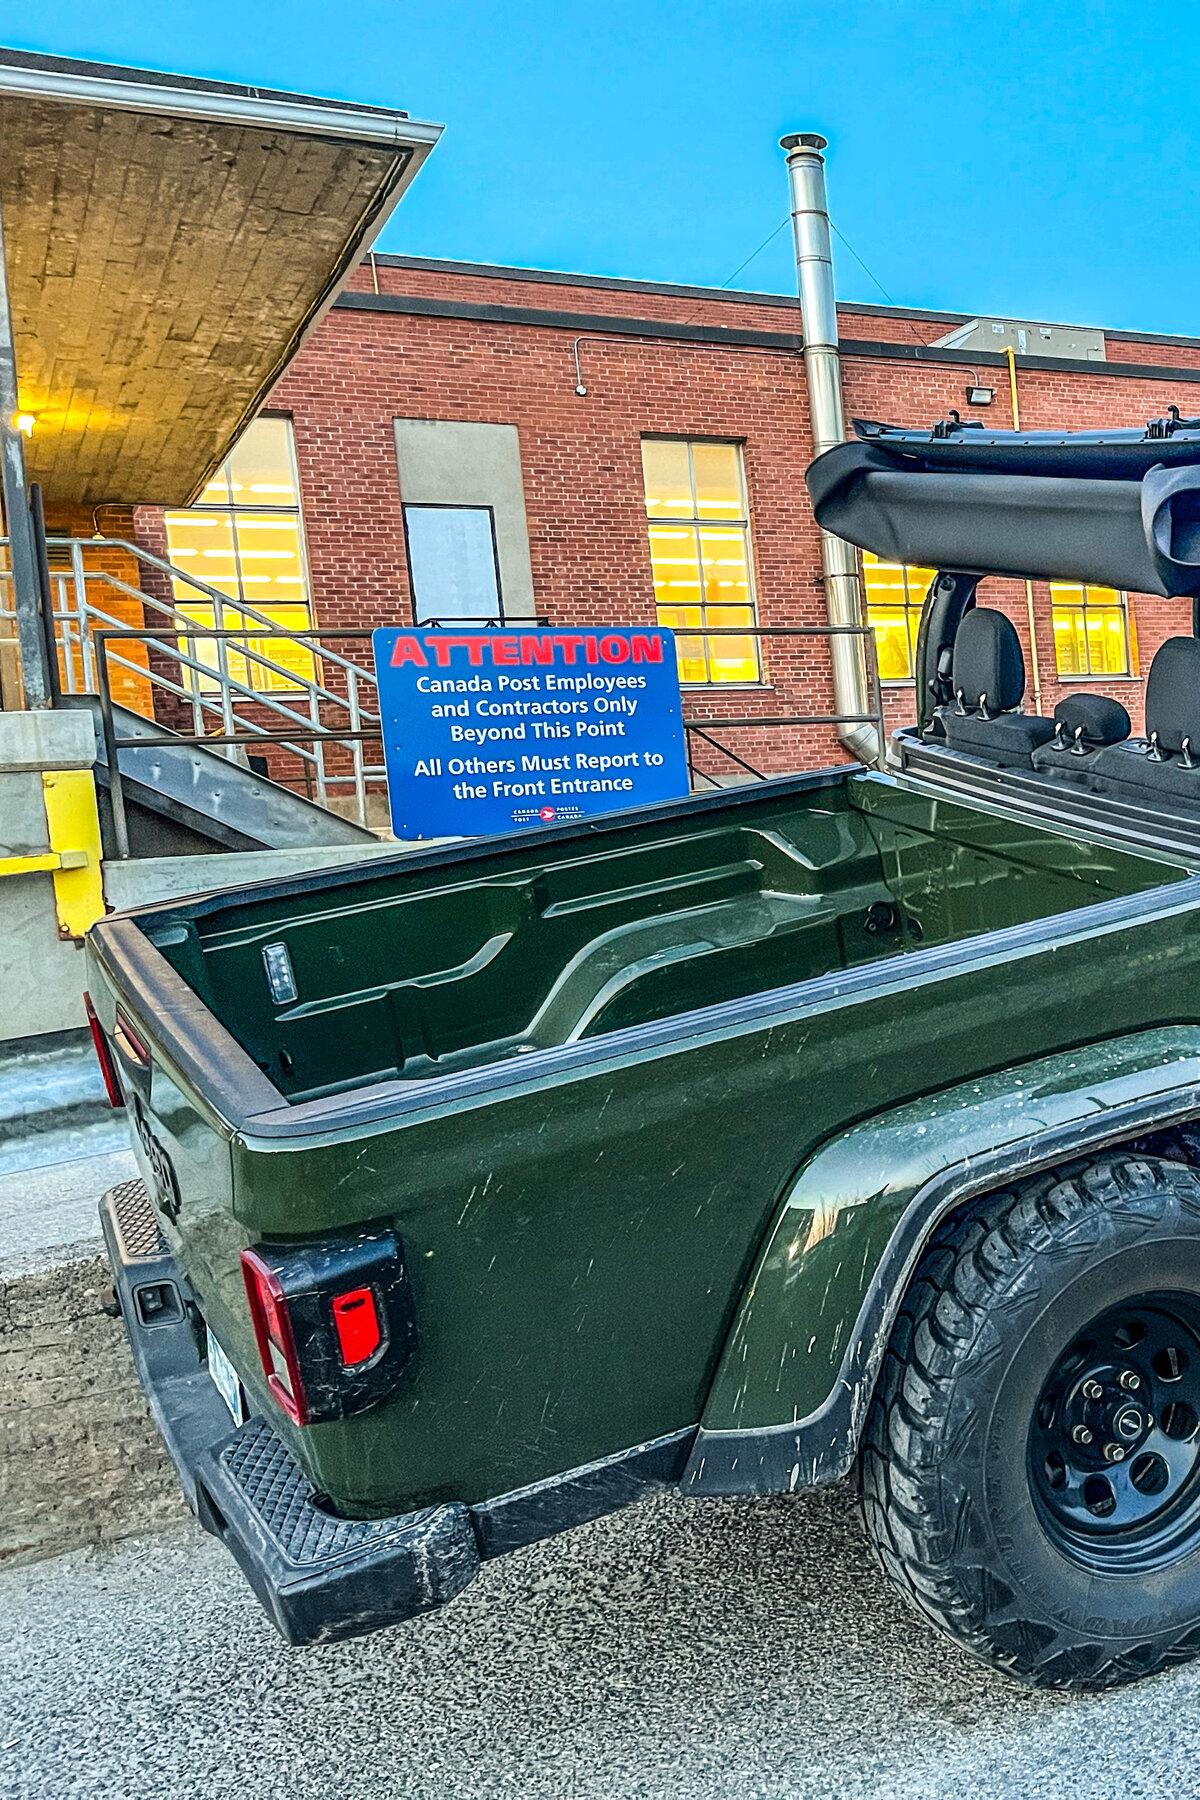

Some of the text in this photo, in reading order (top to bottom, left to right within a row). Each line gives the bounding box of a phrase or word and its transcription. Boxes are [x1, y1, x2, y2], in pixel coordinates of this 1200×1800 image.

[391, 635, 663, 667] ATTENTION
[416, 672, 647, 694] Canada Post Employees
[431, 695, 638, 718] and Contractors Only
[450, 720, 626, 745] Beyond This Point
[414, 751, 664, 777] All Others Must Report to
[452, 778, 633, 800] the Front Entrance
